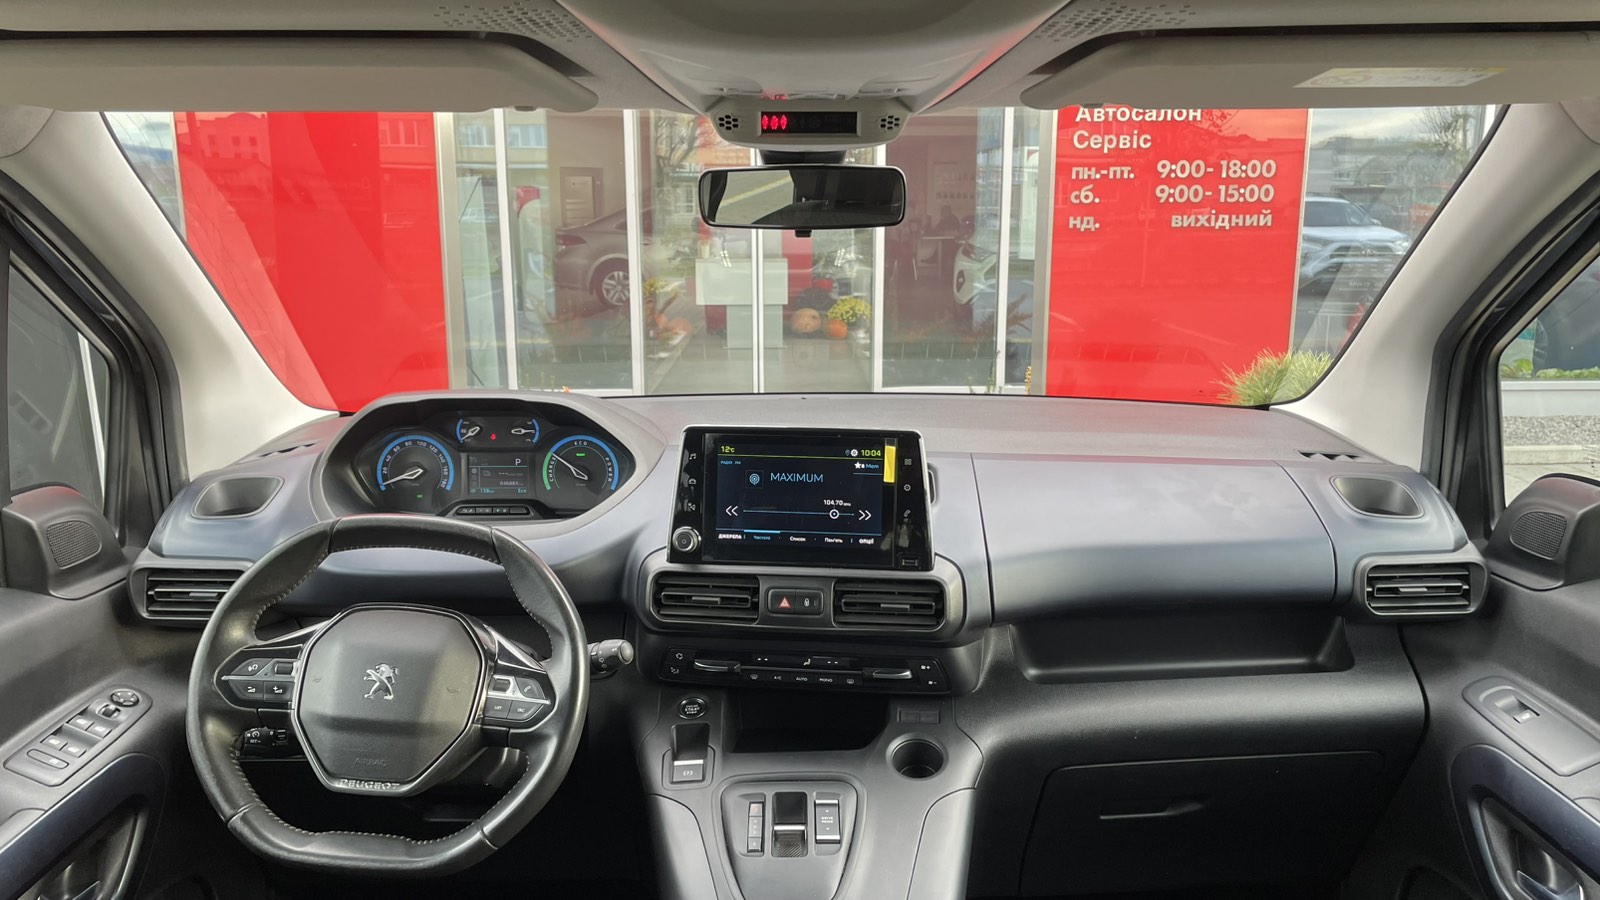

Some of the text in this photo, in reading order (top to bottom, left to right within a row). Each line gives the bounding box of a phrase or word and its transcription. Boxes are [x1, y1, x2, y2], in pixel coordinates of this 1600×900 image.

[1075, 108, 1202, 122] Автосалон
[1072, 130, 1152, 153] Сервіс
[1071, 166, 1135, 180] пн.-пт.
[1070, 184, 1100, 204] сб.
[1068, 209, 1272, 232] нд. вихідний
[514, 458, 522, 466] P
[770, 472, 824, 483] MAXIMUM
[340, 779, 400, 790] PEUGEOT
